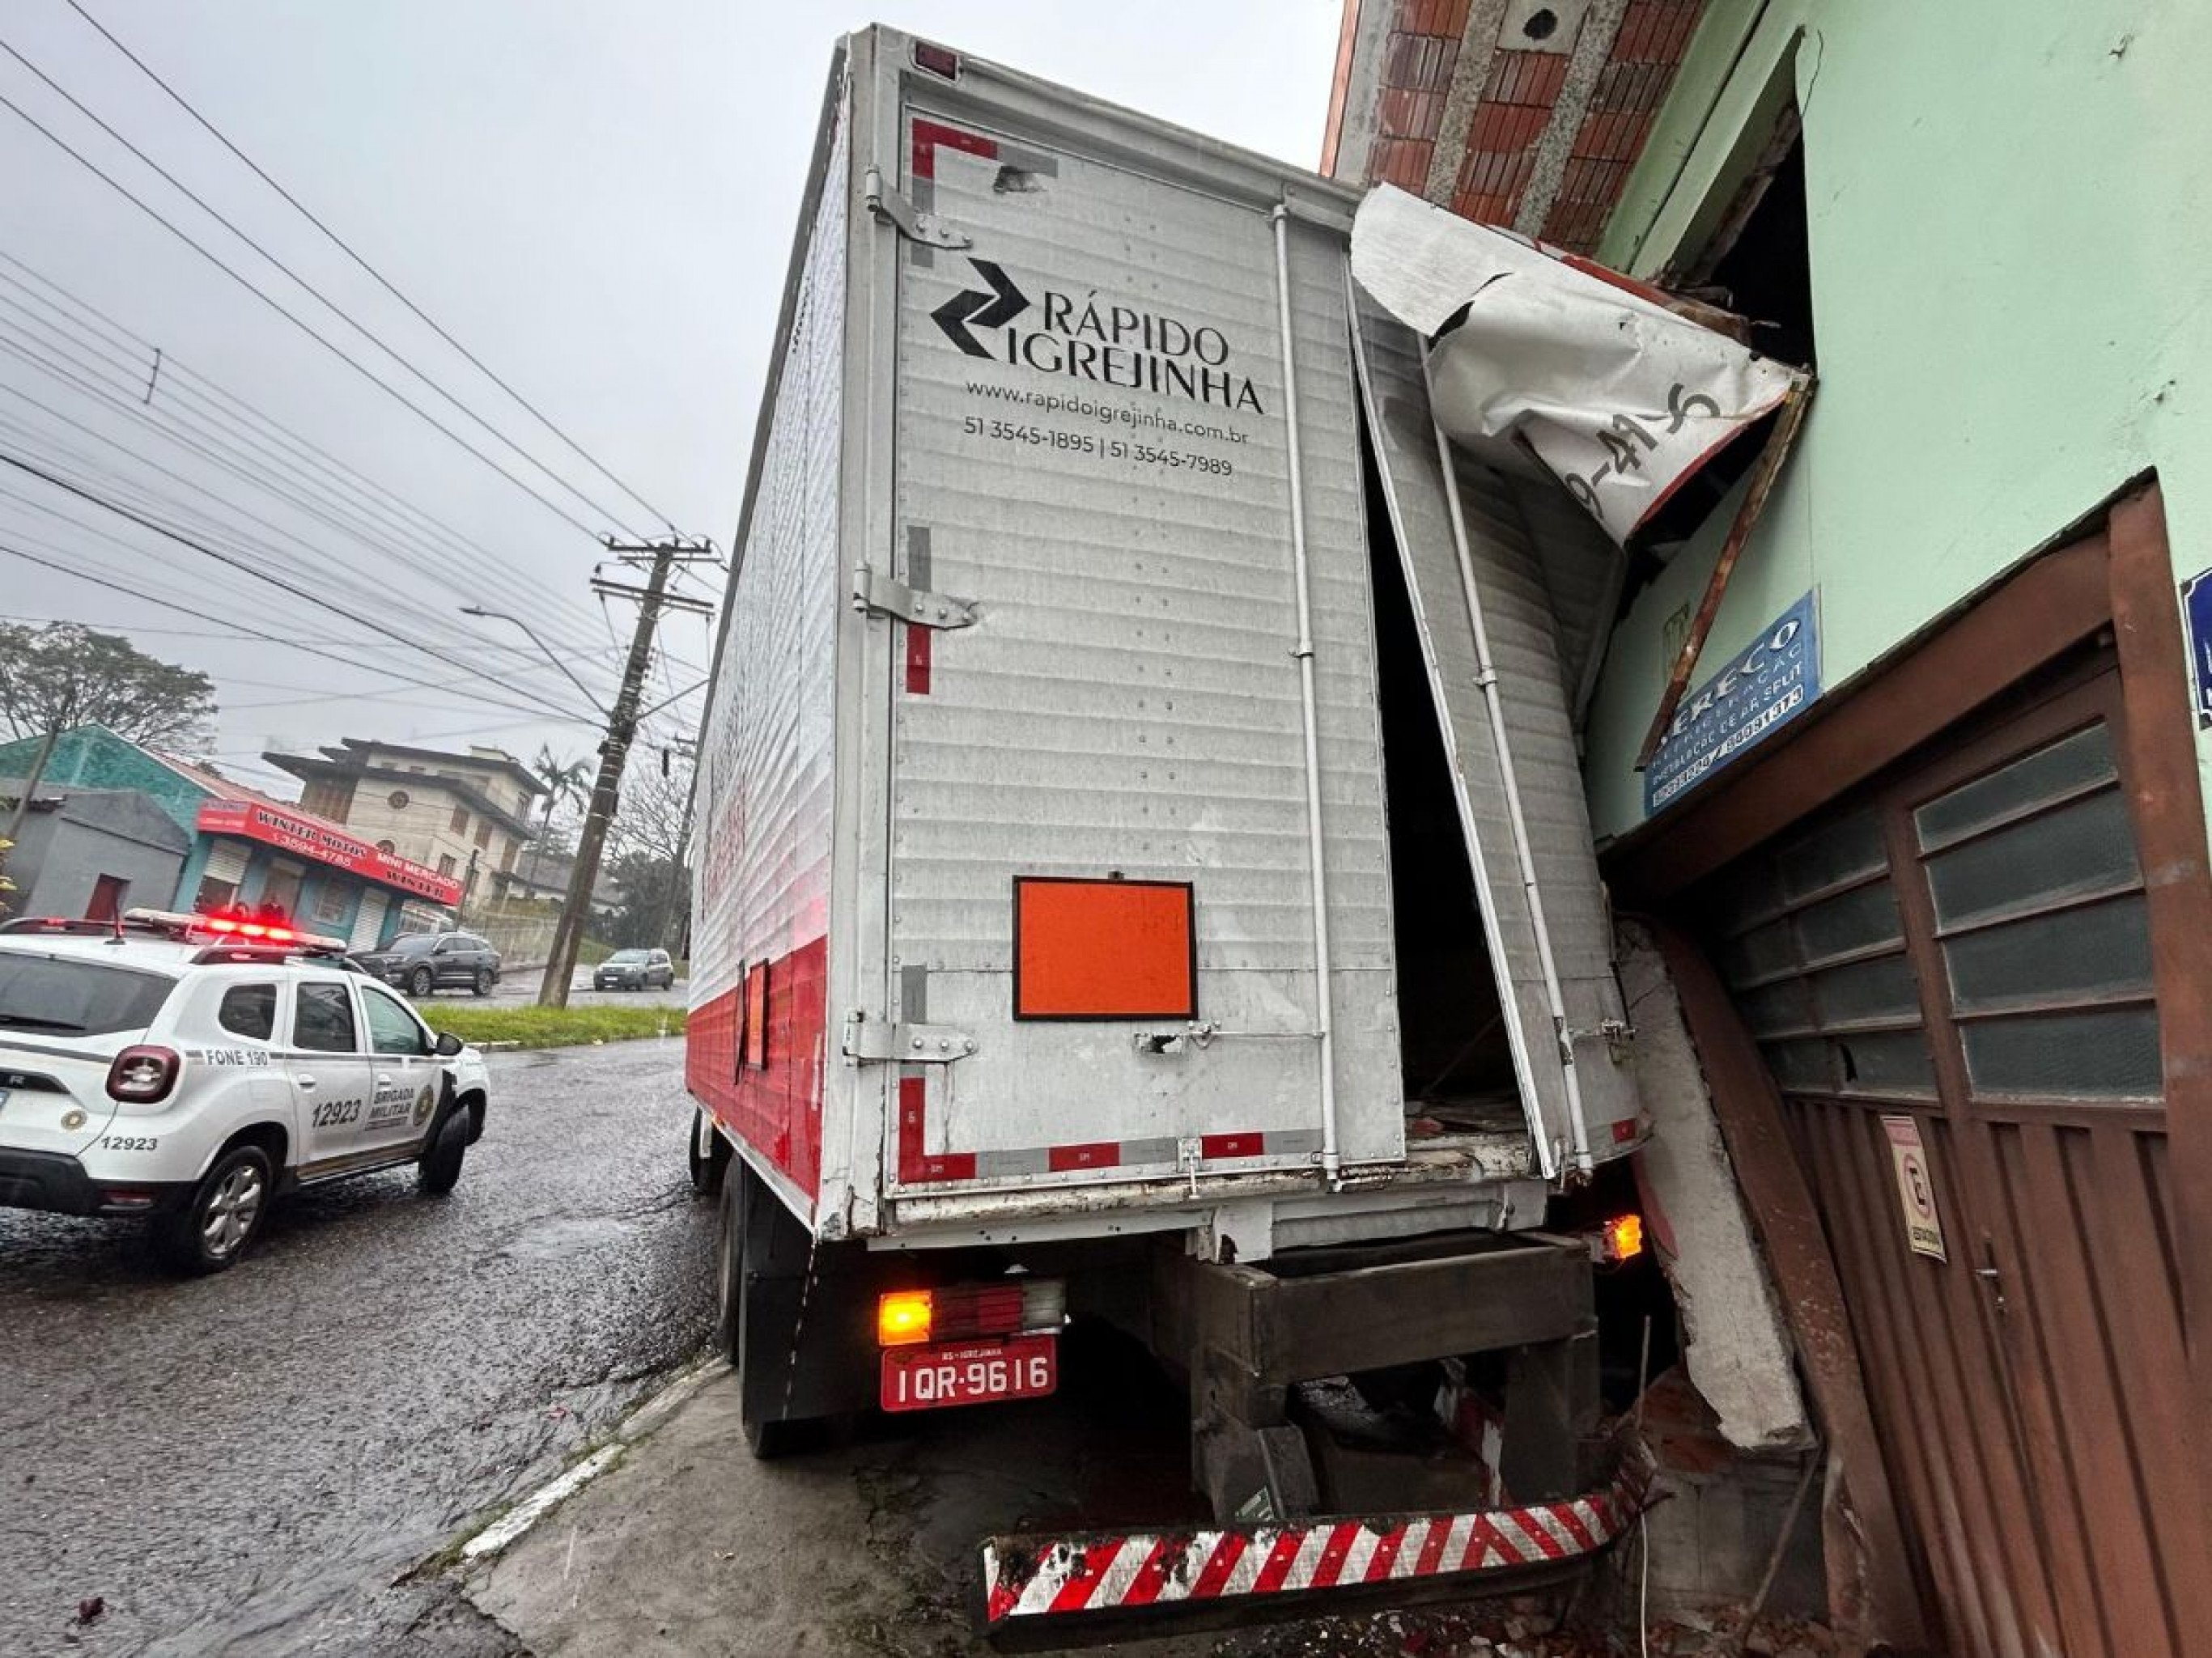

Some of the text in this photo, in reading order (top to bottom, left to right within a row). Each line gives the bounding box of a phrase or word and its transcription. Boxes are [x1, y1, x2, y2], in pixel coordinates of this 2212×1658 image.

[1044, 290, 1229, 366] RÁPIDO
[1007, 327, 1265, 415] IGREJINHA
[965, 380, 1249, 443] www.rapidoigrejinha.com.br
[964, 415, 983, 435] 51
[989, 419, 1093, 453] 3545-1895
[1110, 441, 1129, 459] 51
[1133, 443, 1233, 476] 3545-7989
[206, 1050, 269, 1066] FONE 190
[369, 1101, 411, 1118] MILITAR
[373, 1088, 414, 1105] BRIGADA
[312, 1099, 362, 1128] 12923
[101, 1136, 158, 1151] 12923
